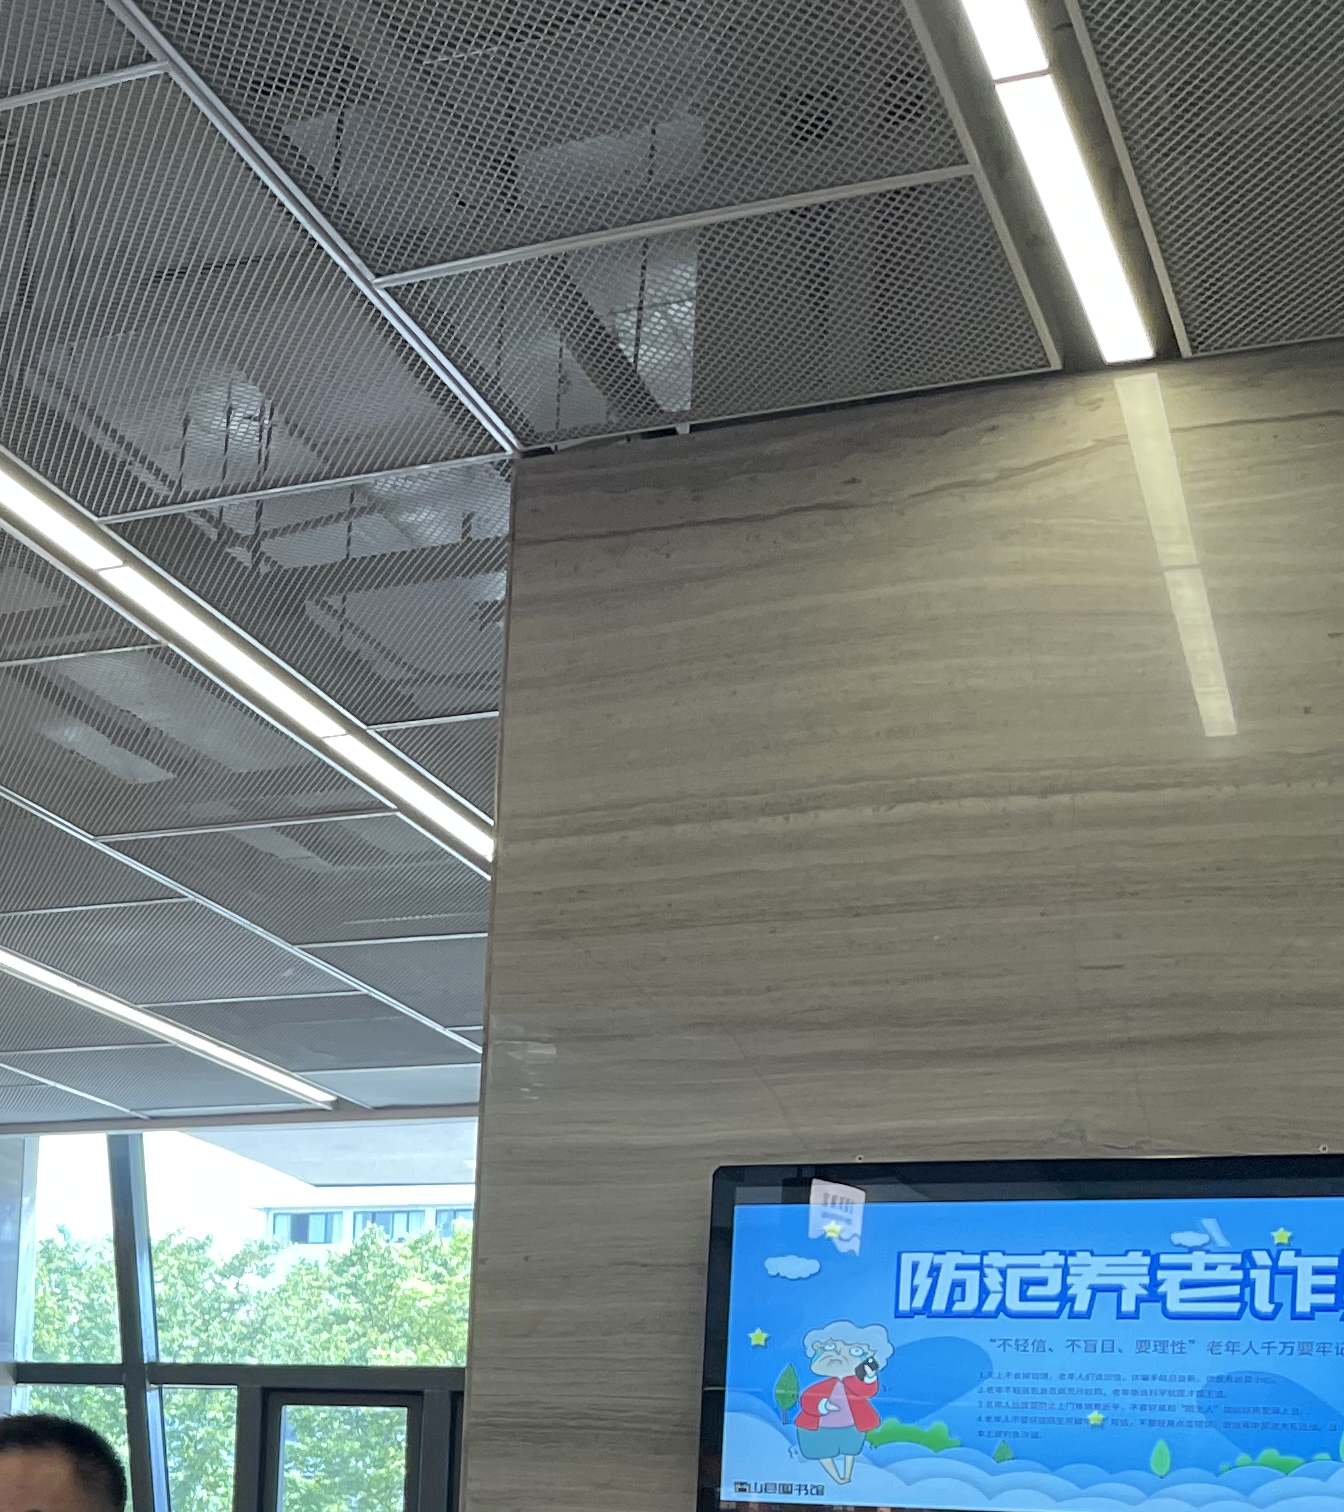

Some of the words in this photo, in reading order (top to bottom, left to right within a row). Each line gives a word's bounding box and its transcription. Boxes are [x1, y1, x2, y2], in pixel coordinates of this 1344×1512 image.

[895, 1250, 1342, 1320] 防范养老诈
